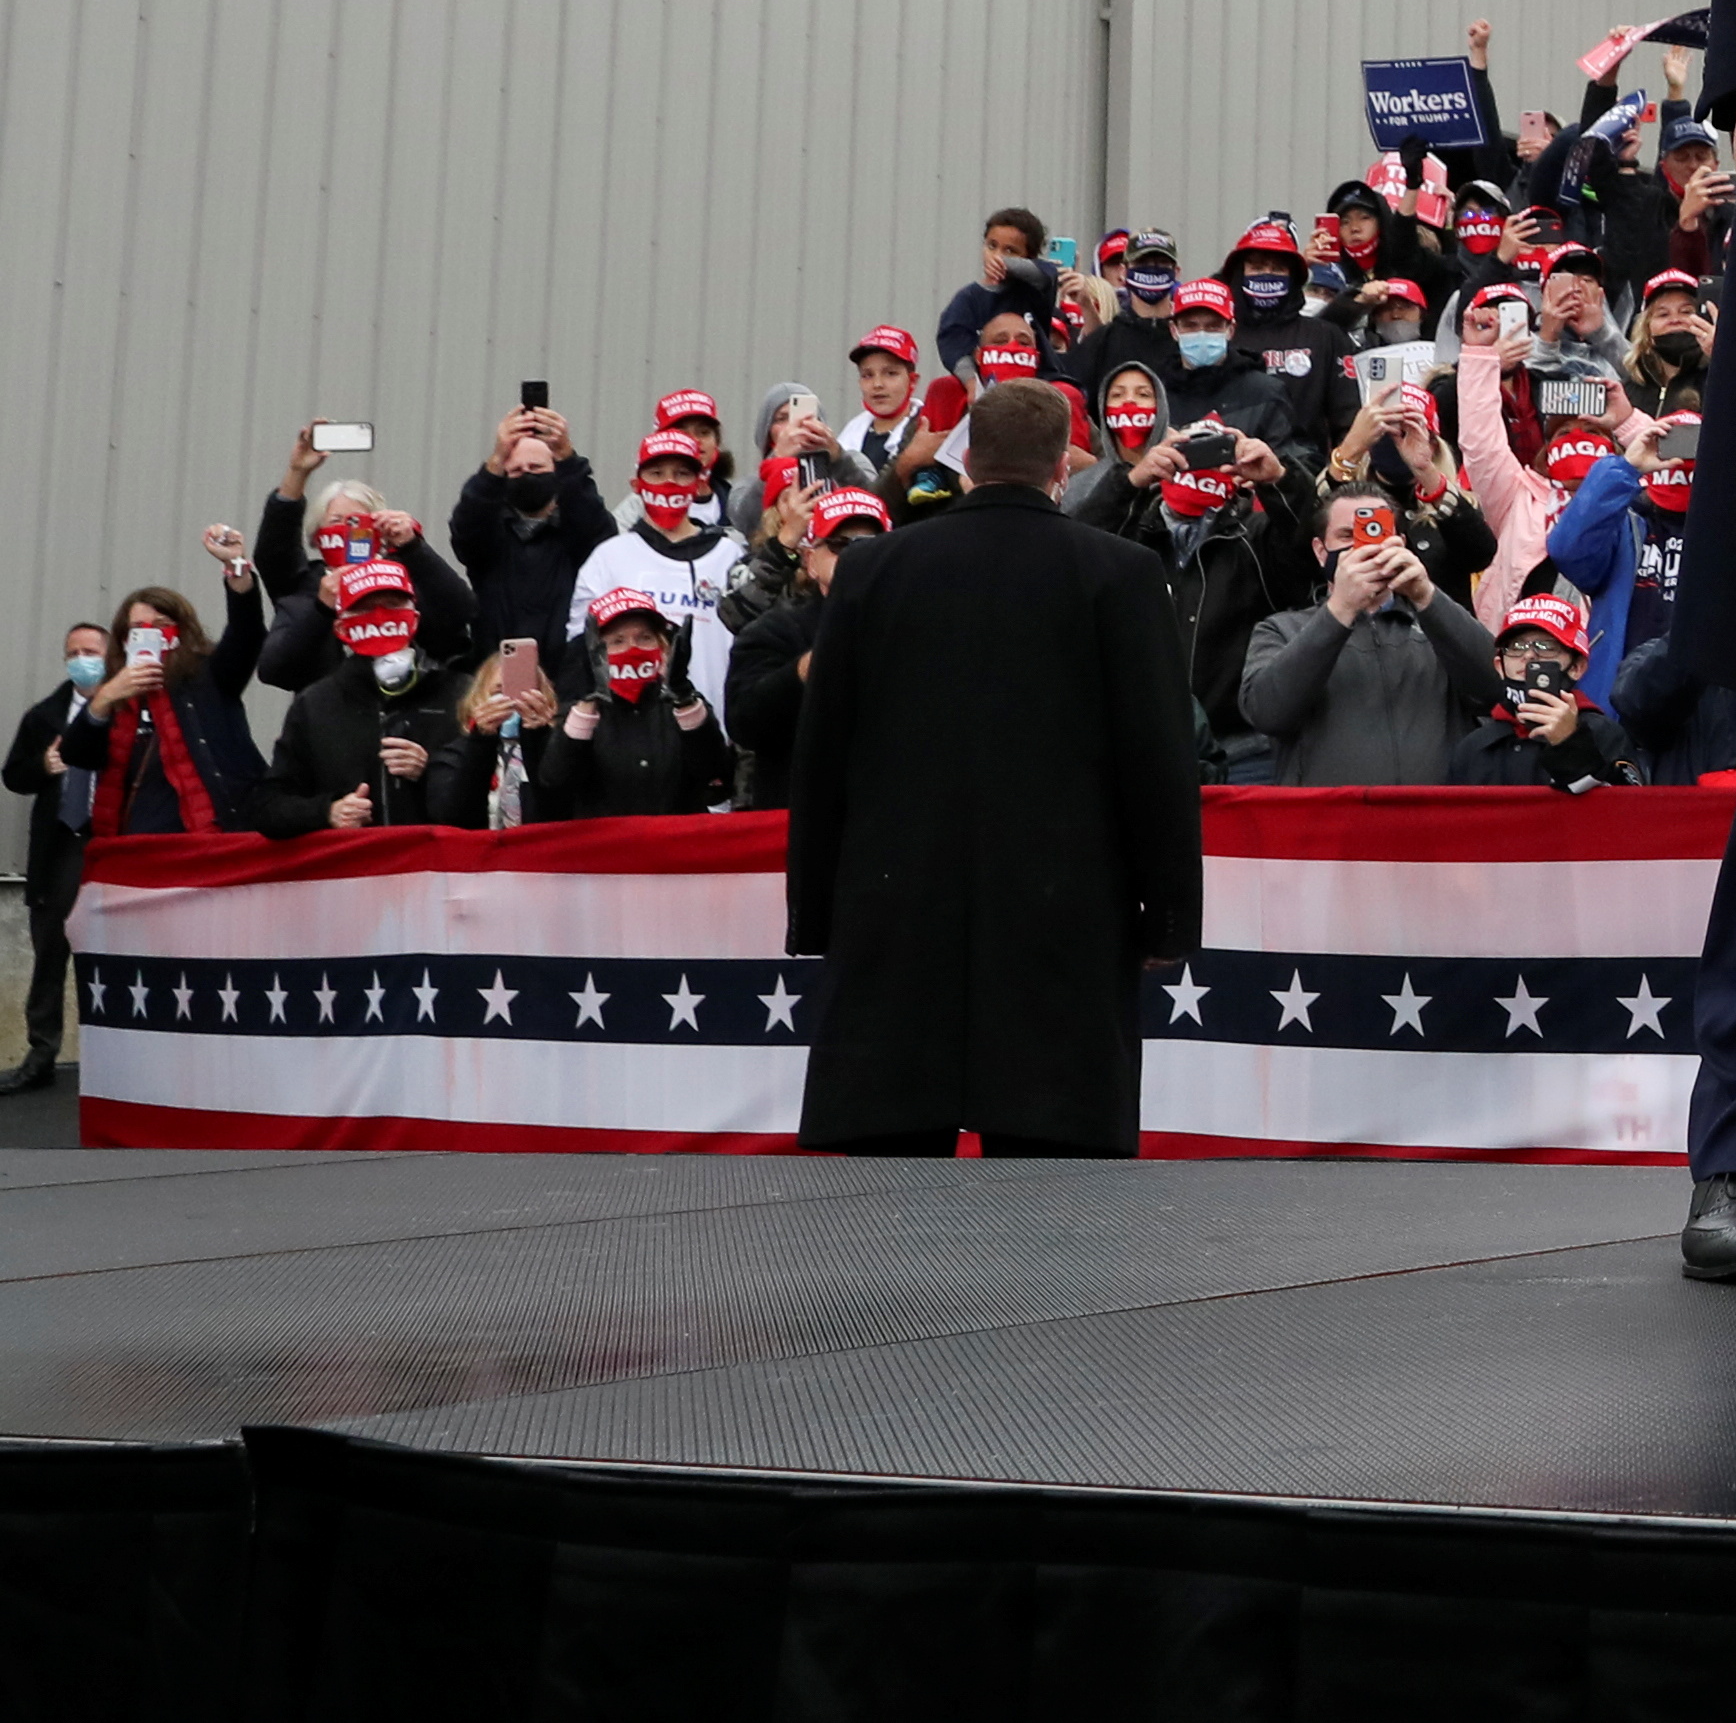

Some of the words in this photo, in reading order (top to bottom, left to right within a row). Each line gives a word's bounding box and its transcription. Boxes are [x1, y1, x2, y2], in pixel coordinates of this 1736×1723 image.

[1369, 90, 1467, 114] Workers
[1388, 115, 1408, 126] FOR
[1411, 113, 1450, 125] TRUMP
[1133, 271, 1171, 284] TRUMP
[1249, 280, 1286, 294] TRUMP
[1200, 282, 1228, 296] AMERICA
[982, 350, 1037, 366] MAGA
[1548, 441, 1608, 466] MAGA
[819, 494, 845, 511] MAKE
[845, 490, 884, 510] AMERICA
[823, 504, 850, 520] GREAT
[850, 504, 880, 518] AGAIN
[369, 562, 406, 582] AMERICA
[589, 596, 614, 614] MAKE
[613, 587, 654, 607] AMERICA
[1533, 598, 1575, 622] AMERICA
[1535, 610, 1567, 630] AGAIN
[349, 620, 409, 642] MAGA
